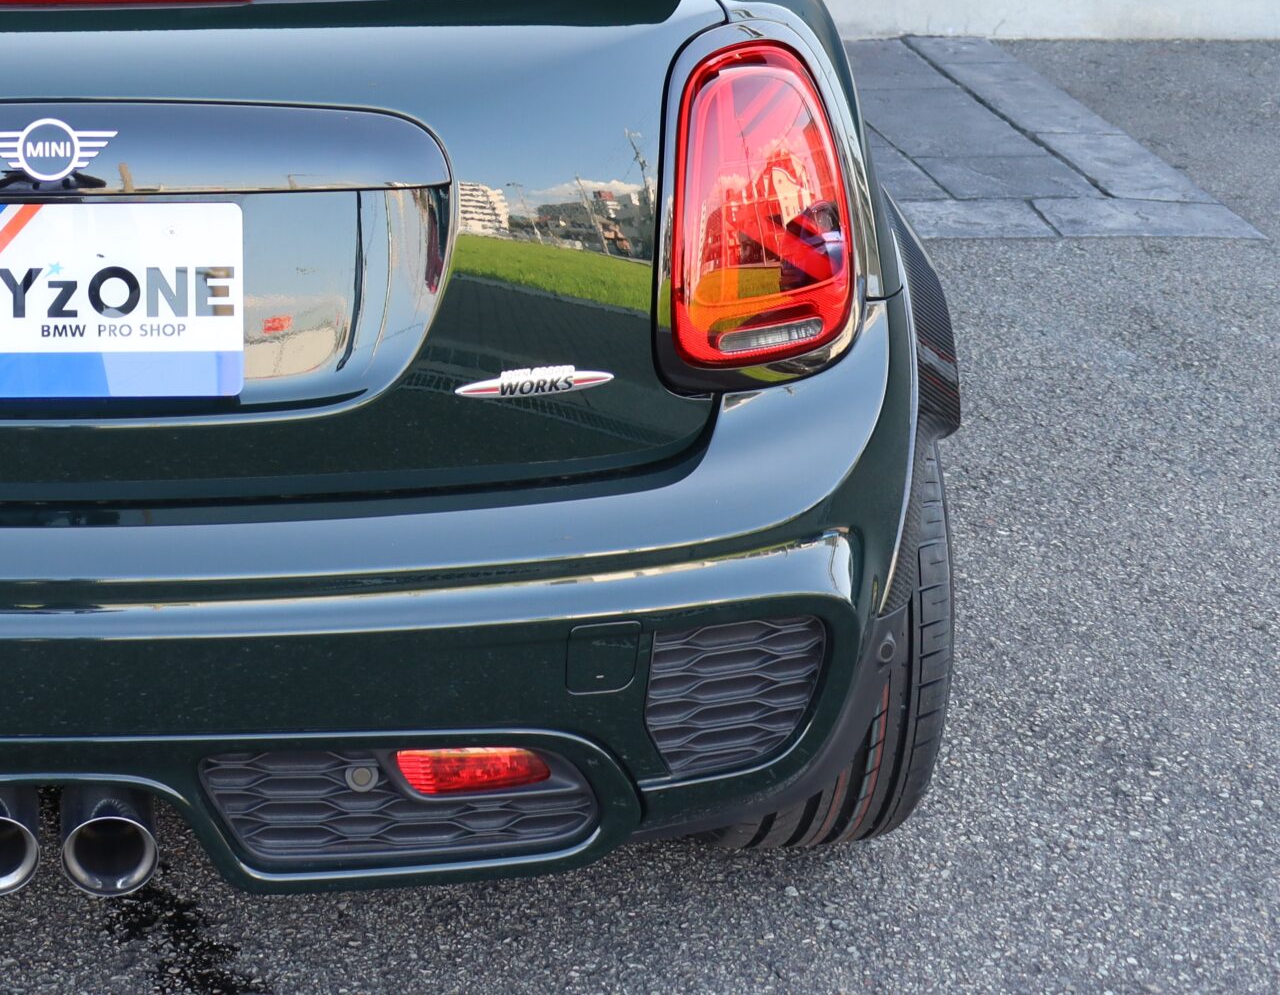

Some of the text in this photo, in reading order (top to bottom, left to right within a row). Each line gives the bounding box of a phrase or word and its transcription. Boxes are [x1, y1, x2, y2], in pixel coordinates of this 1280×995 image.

[26, 141, 71, 158] MINI
[40, 323, 186, 337] BMW PRO SHOP
[500, 376, 573, 395] WORKS
